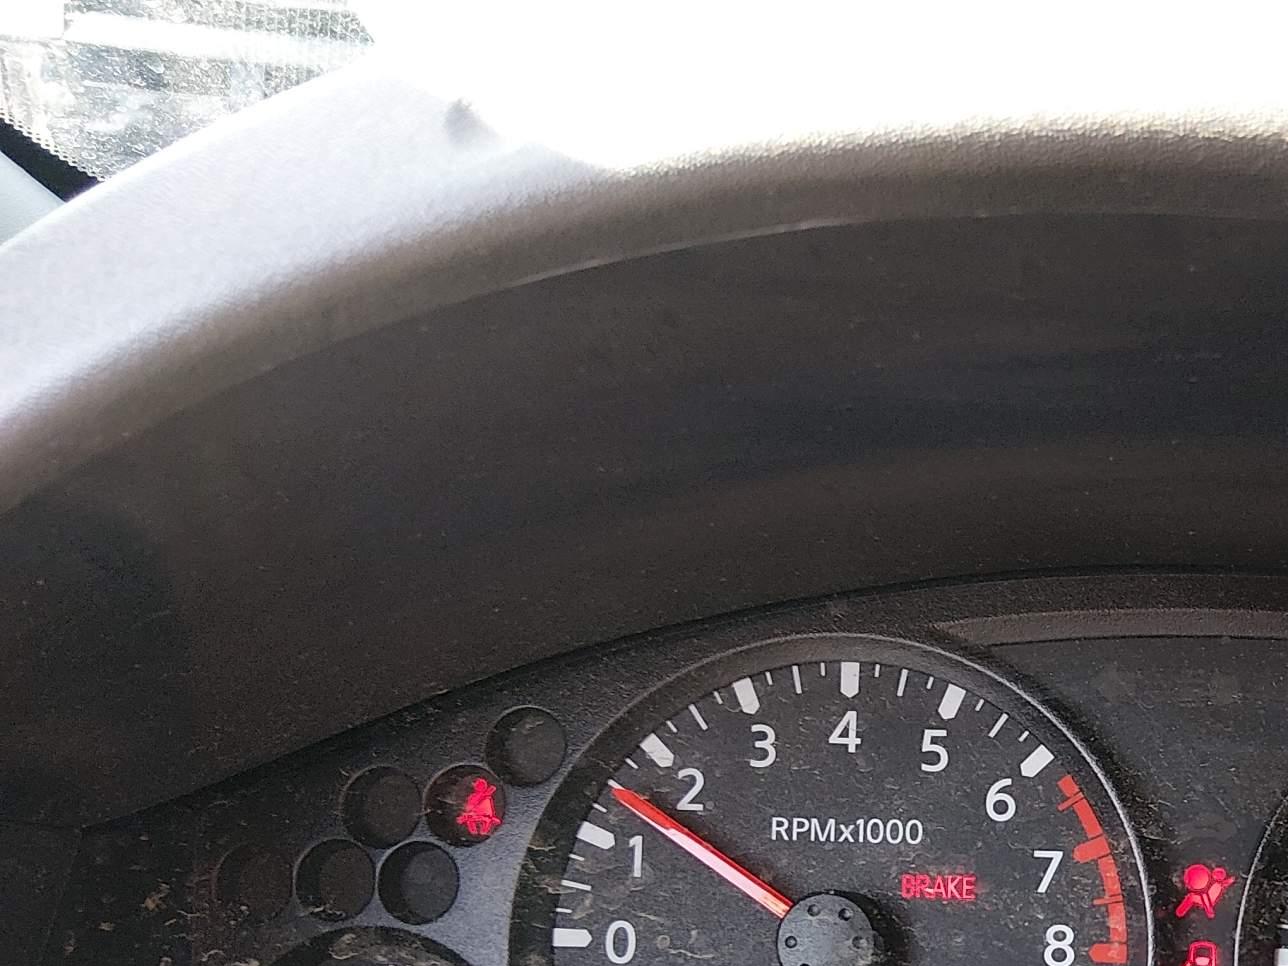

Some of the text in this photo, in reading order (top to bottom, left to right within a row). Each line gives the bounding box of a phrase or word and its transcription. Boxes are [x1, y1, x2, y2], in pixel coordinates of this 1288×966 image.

[750, 724, 776, 767] 3
[829, 711, 861, 752] 4
[922, 729, 948, 772] 5
[677, 768, 704, 810] 2
[986, 779, 1016, 821] 6
[772, 817, 922, 844] RPMx1000
[629, 836, 642, 877] 1
[1034, 851, 1063, 893] 7
[901, 874, 976, 899] BRAKE
[606, 921, 636, 964] 0
